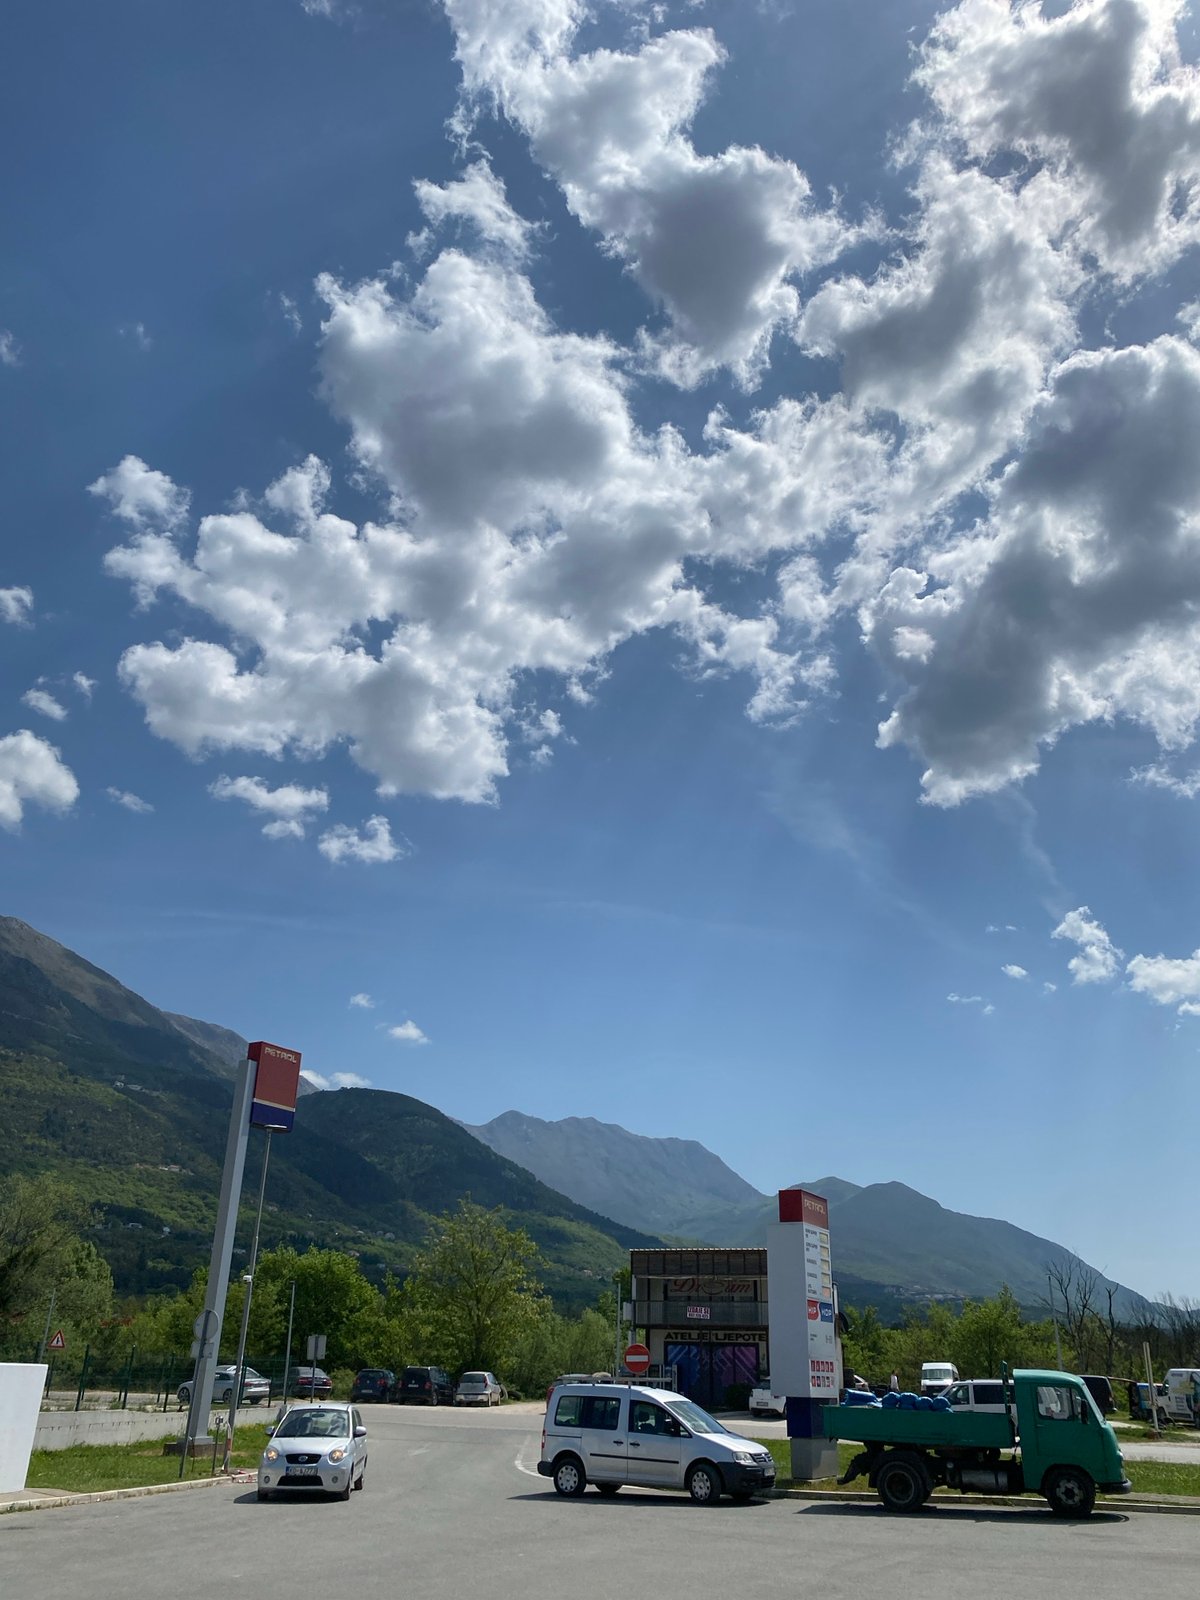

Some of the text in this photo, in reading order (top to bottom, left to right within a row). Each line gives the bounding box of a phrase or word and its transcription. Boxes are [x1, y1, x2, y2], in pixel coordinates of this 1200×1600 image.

[264, 1047, 297, 1063] PETROL
[804, 1199, 826, 1215] PETROL
[664, 1331, 710, 1341] ATELJE
